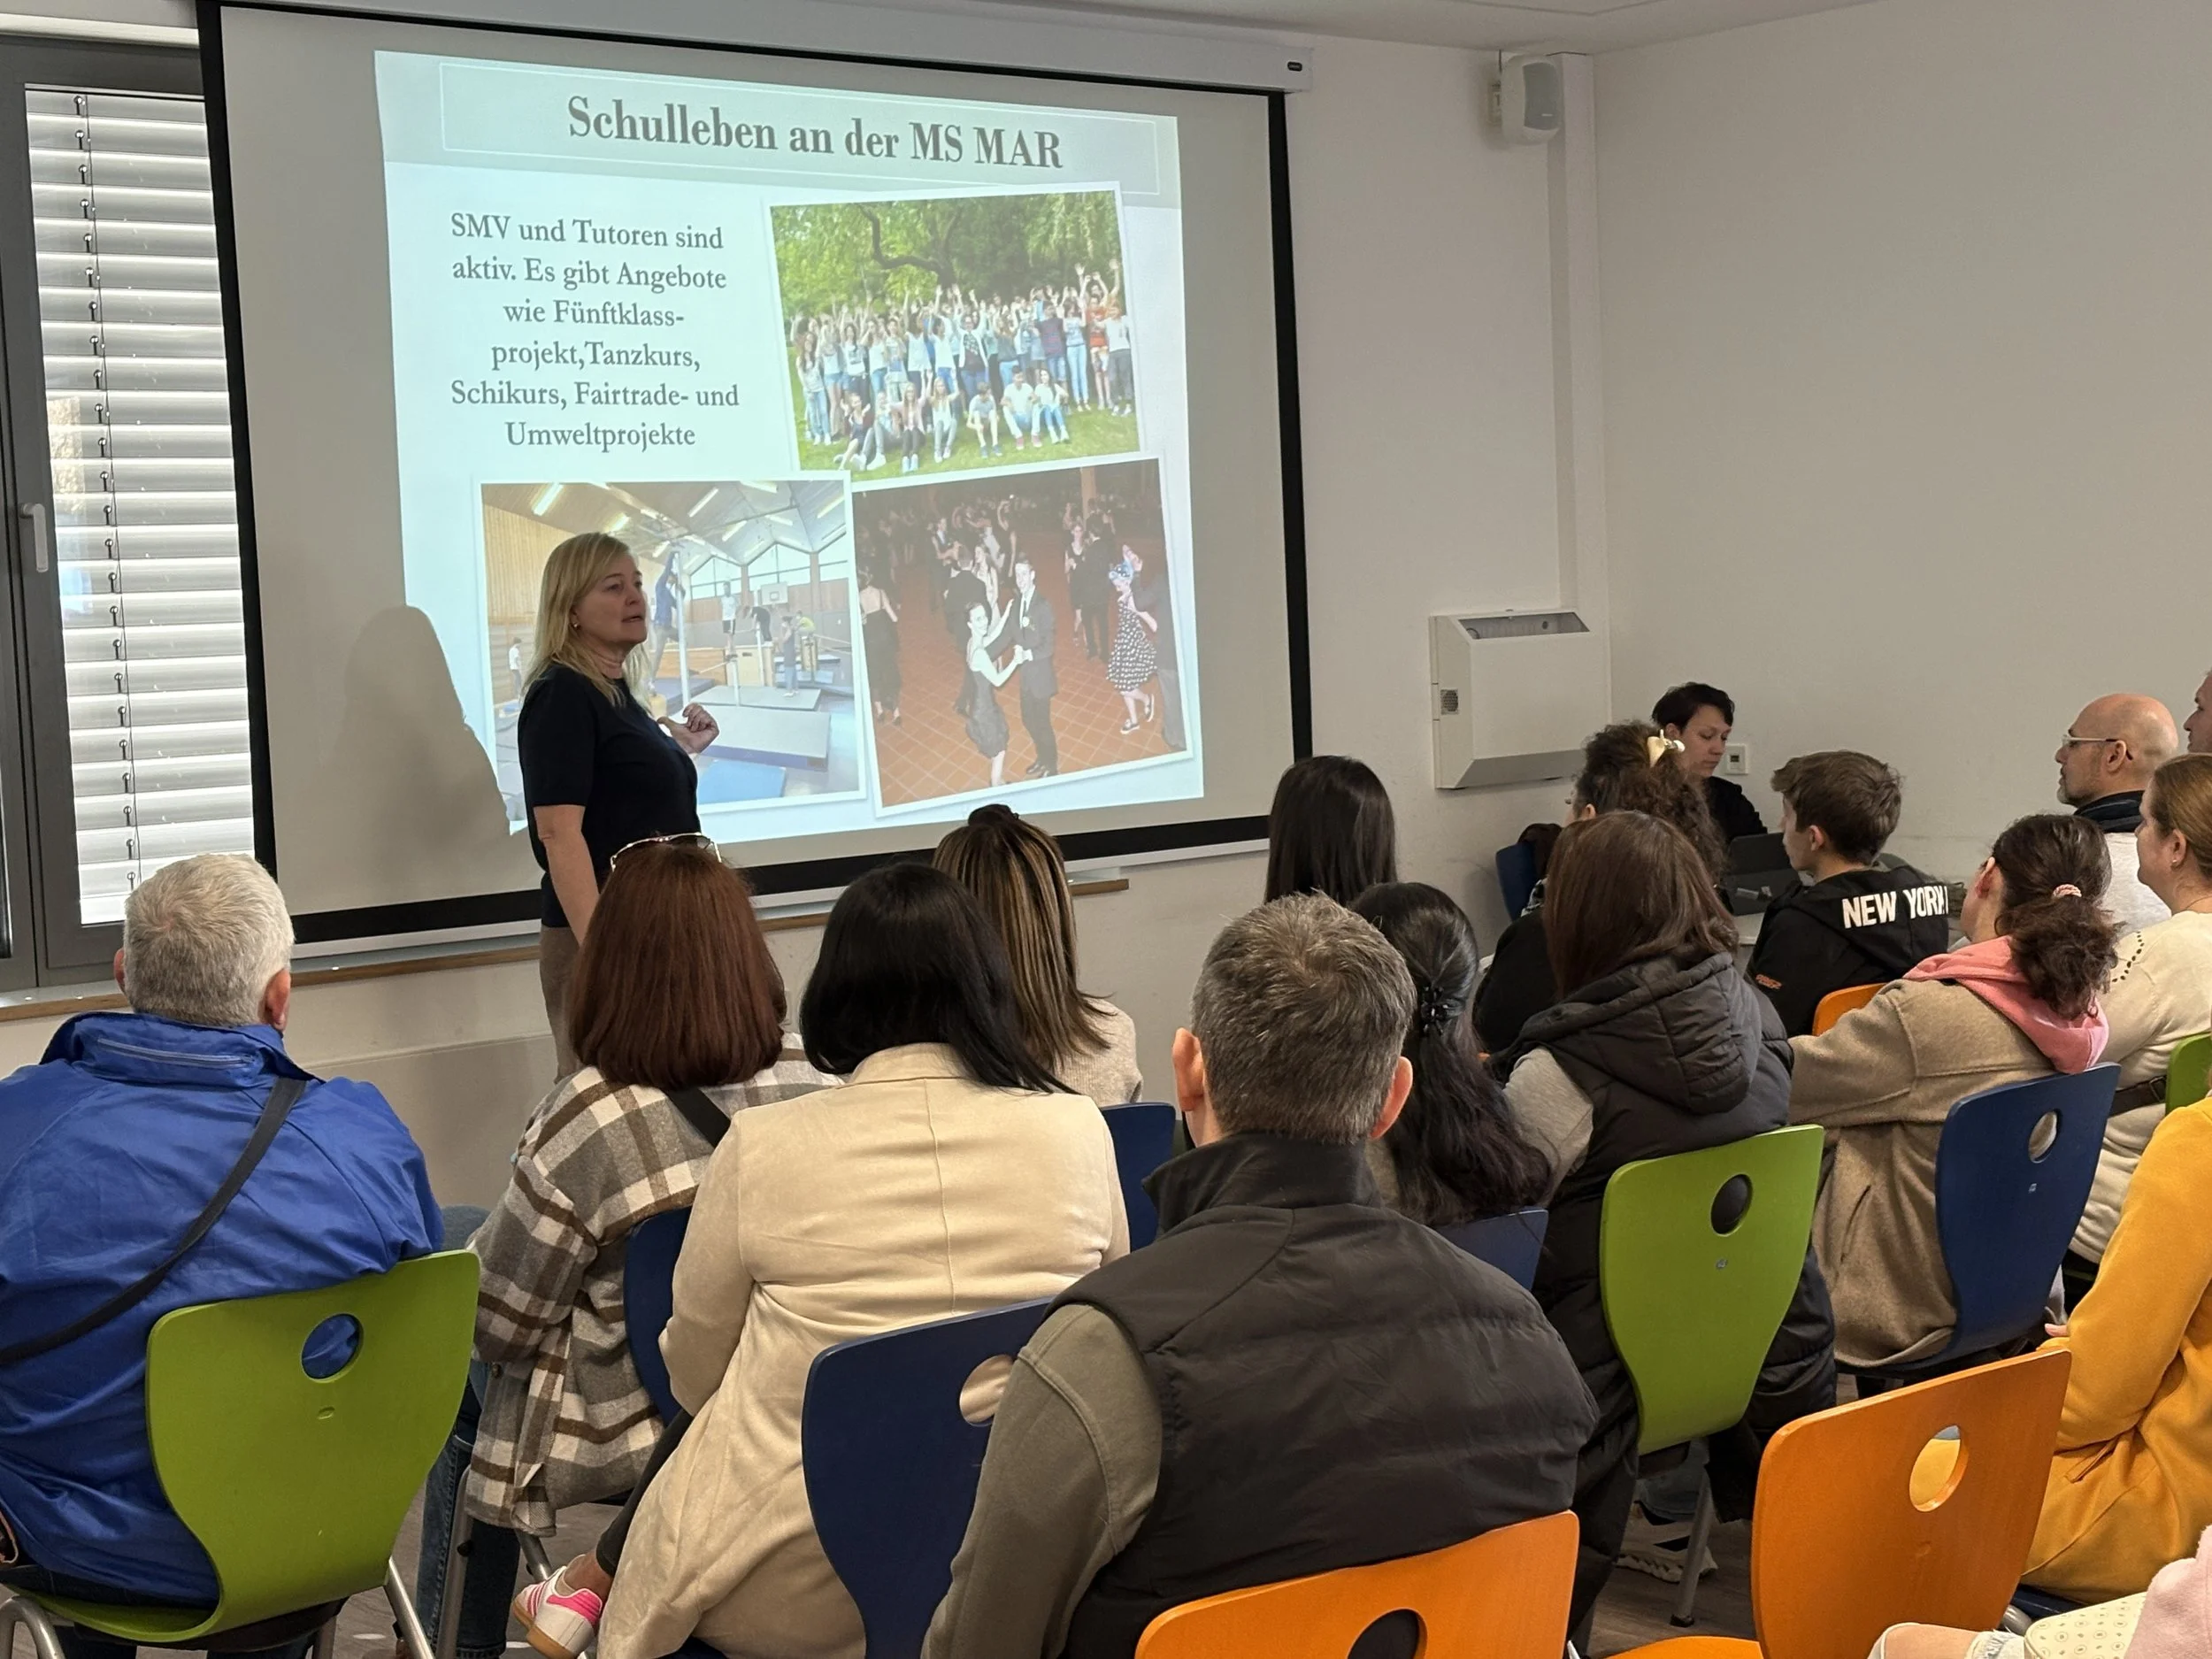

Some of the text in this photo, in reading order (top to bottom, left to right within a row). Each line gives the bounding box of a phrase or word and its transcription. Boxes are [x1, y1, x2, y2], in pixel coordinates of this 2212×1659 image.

[568, 96, 1064, 169] Schulleben an der MS MAR
[450, 212, 724, 249] SMV und Tutoren sind
[452, 255, 726, 295] aktiv. Es gibt Angebote
[503, 297, 685, 327] wie Fünftklass-
[450, 380, 740, 411] Schikurs, Fairtrade- und
[504, 421, 696, 453] Umweltprojekte
[1841, 890, 1897, 929] NEW
